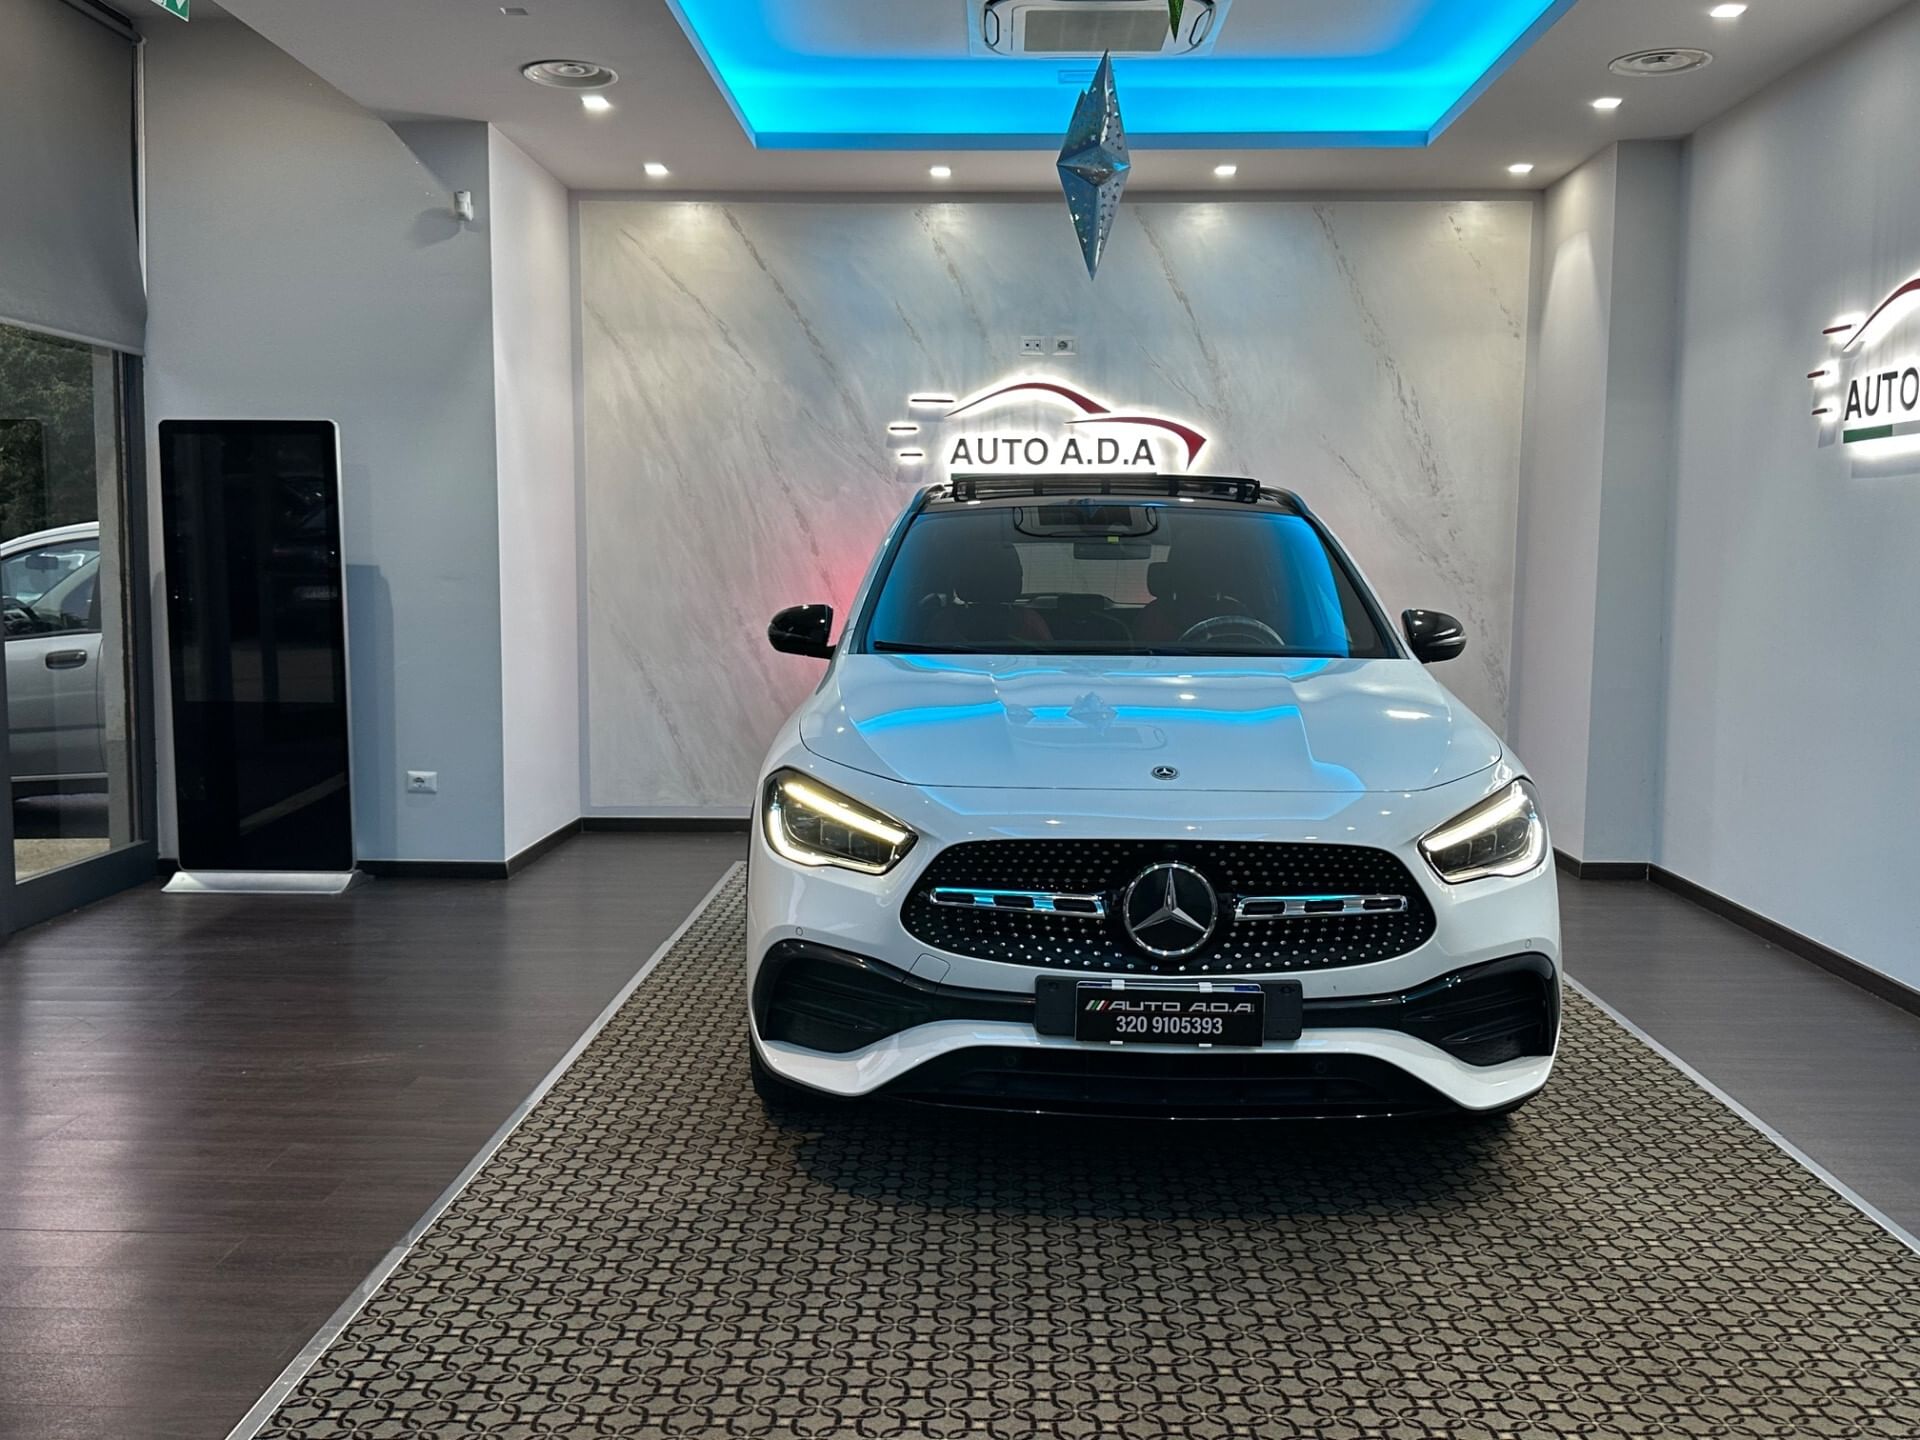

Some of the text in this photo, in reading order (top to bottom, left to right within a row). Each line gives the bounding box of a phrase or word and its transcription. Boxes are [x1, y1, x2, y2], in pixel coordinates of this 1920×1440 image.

[1844, 367, 1920, 421] AUTO
[950, 437, 1155, 466] AUTO A.D.A
[1108, 1000, 1181, 1012] AUTO
[1116, 1015, 1223, 1035] 320 9105393
